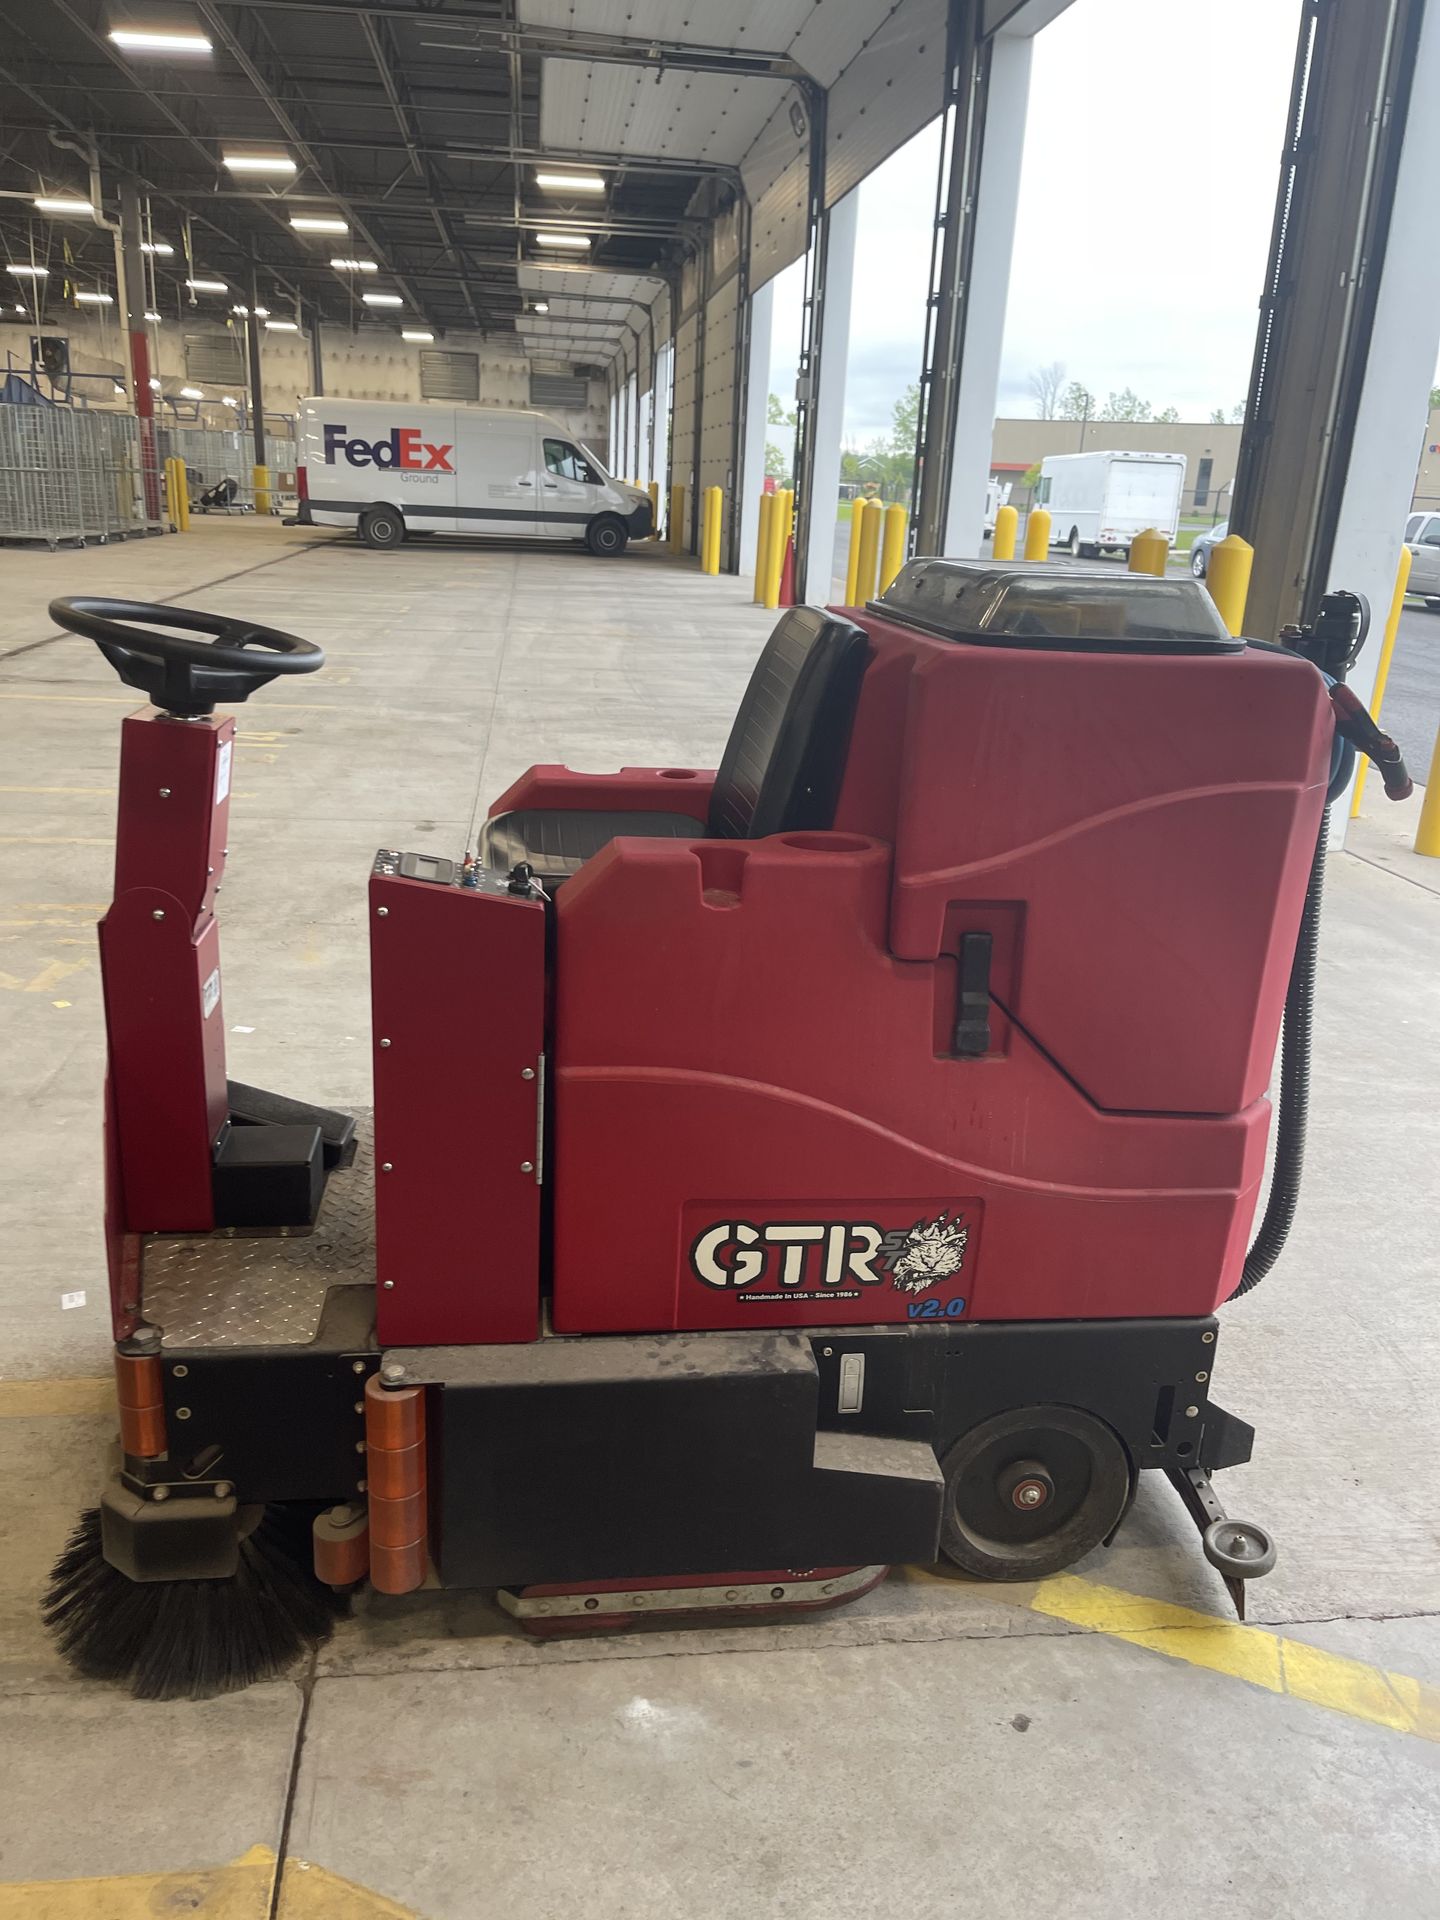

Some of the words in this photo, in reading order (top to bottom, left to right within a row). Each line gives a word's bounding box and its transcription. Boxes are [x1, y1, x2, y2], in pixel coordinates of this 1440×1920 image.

[323, 424, 454, 470] FedEx
[401, 472, 439, 484] Ground
[695, 1224, 883, 1285] GTR
[908, 1298, 965, 1317] v2.0
